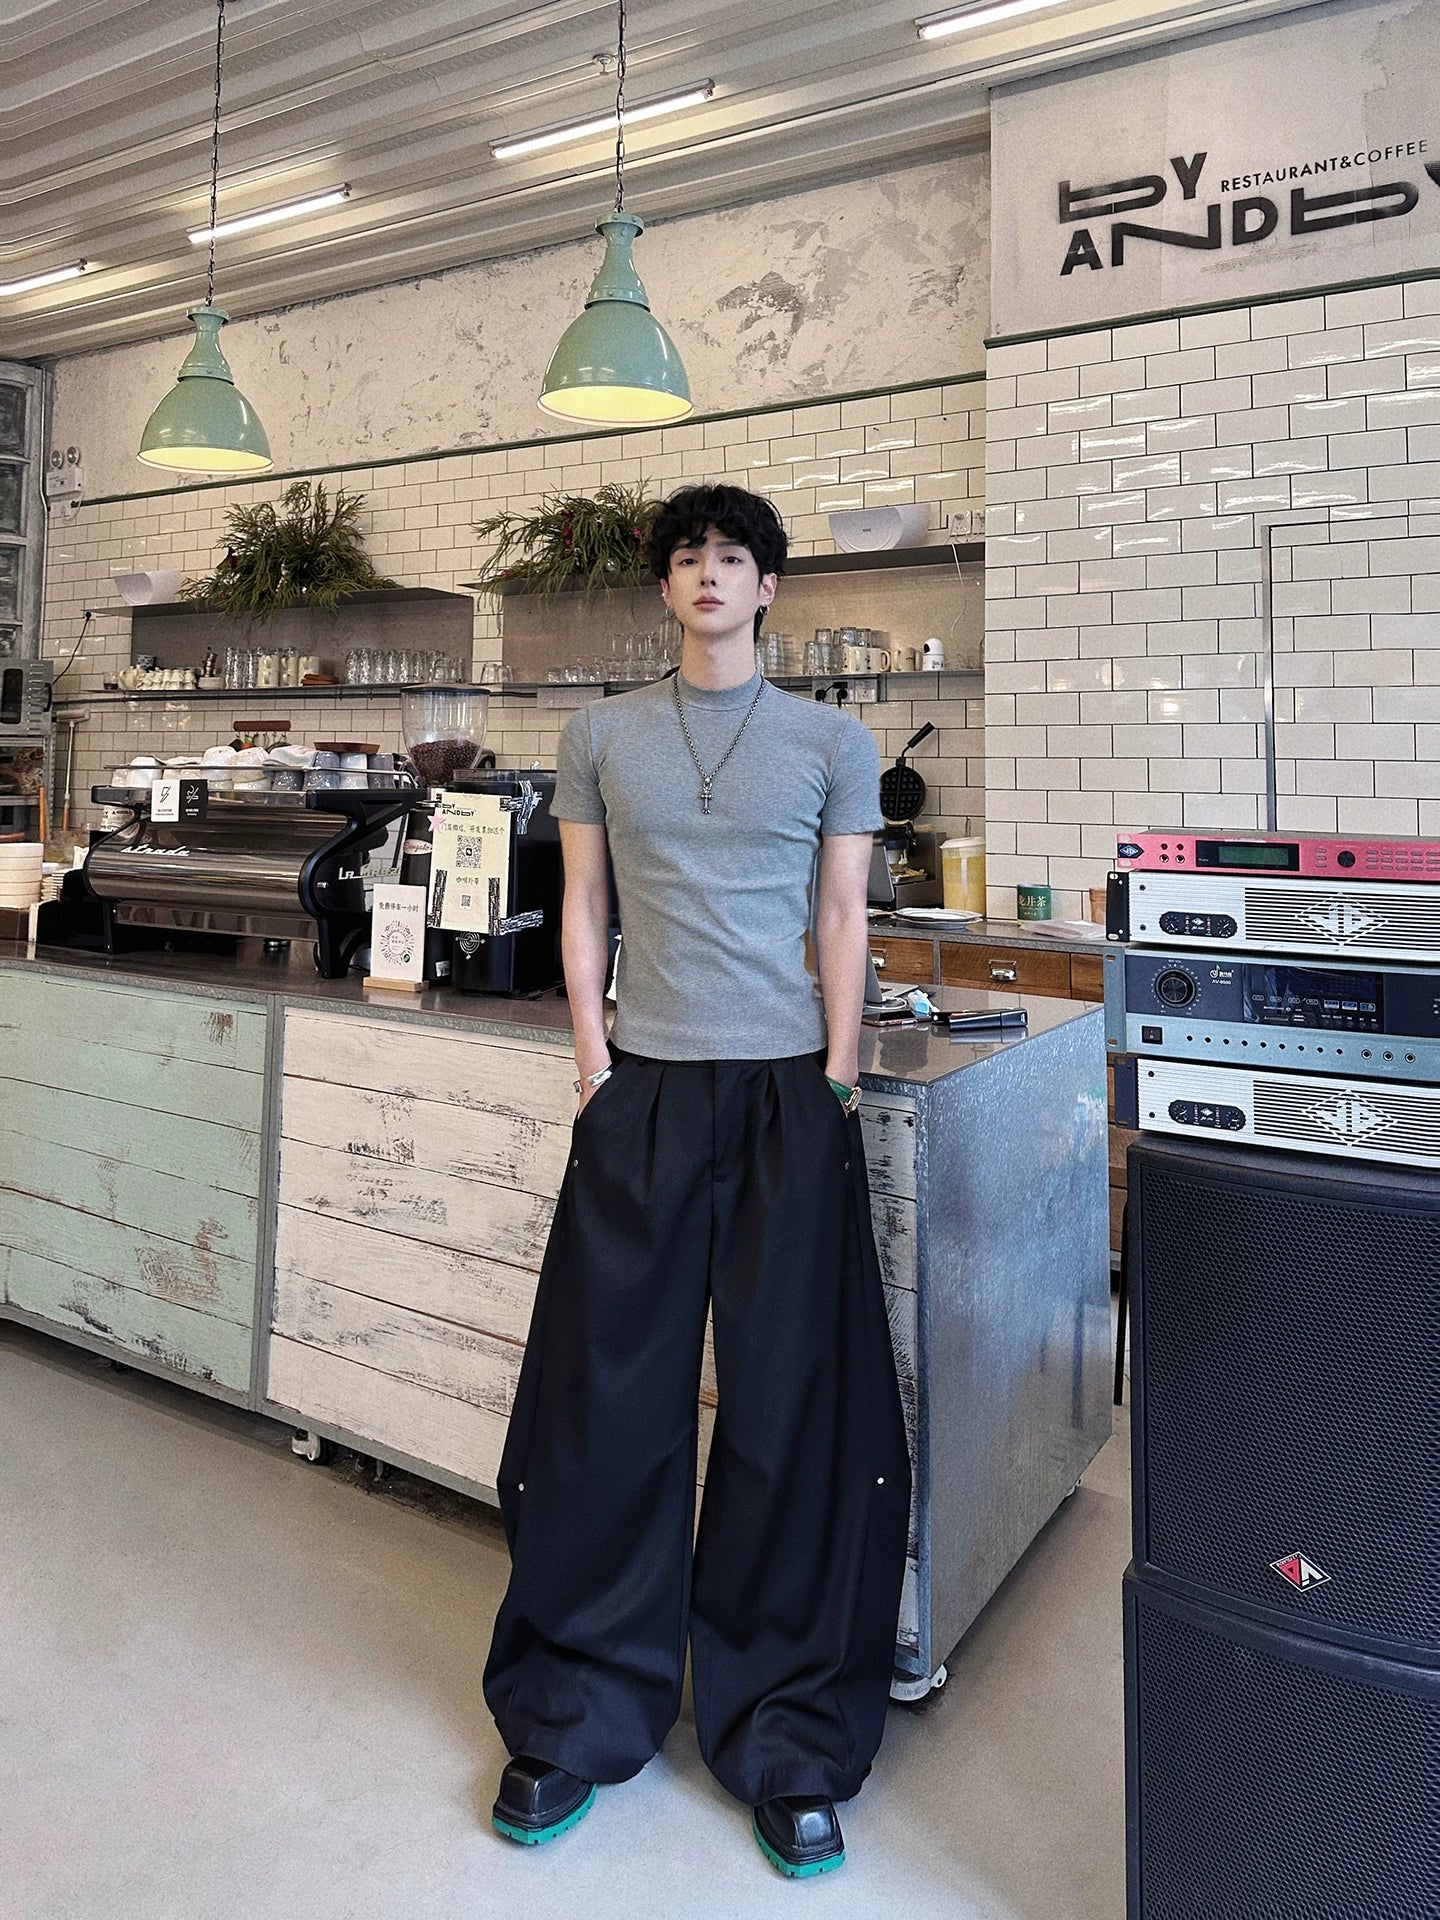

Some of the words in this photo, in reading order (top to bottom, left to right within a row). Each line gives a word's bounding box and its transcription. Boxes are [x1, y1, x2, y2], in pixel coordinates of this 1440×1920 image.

[1220, 139, 1428, 193] RESTAURANT&COFFEE
[378, 901, 419, 913] 免费停车一小时
